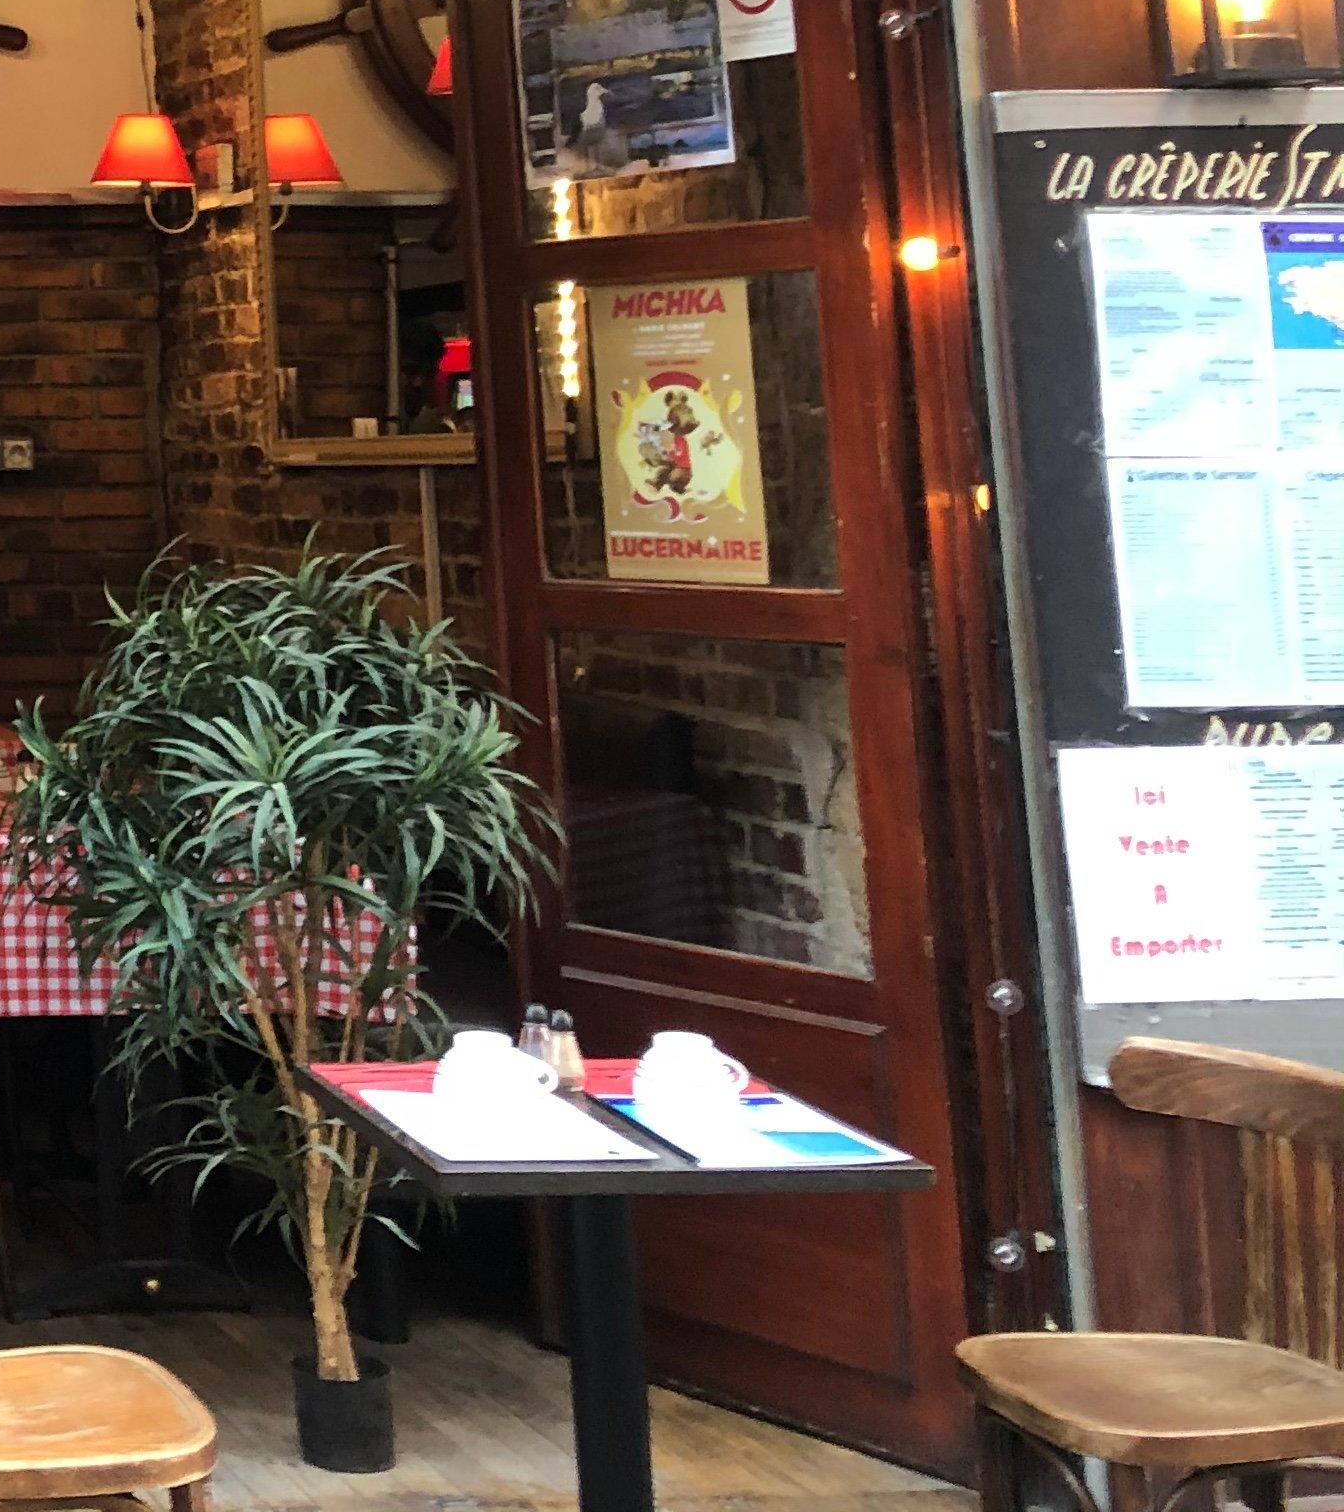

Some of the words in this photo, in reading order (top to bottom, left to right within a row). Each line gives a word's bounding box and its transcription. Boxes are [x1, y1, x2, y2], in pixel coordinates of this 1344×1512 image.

[1046, 151, 1097, 202] LA
[612, 288, 726, 319] MICHKA
[611, 537, 762, 560] LUCERNAIRE
[1134, 785, 1165, 805] Ici
[1118, 835, 1189, 856] Vente
[1111, 934, 1222, 958] Emporter
